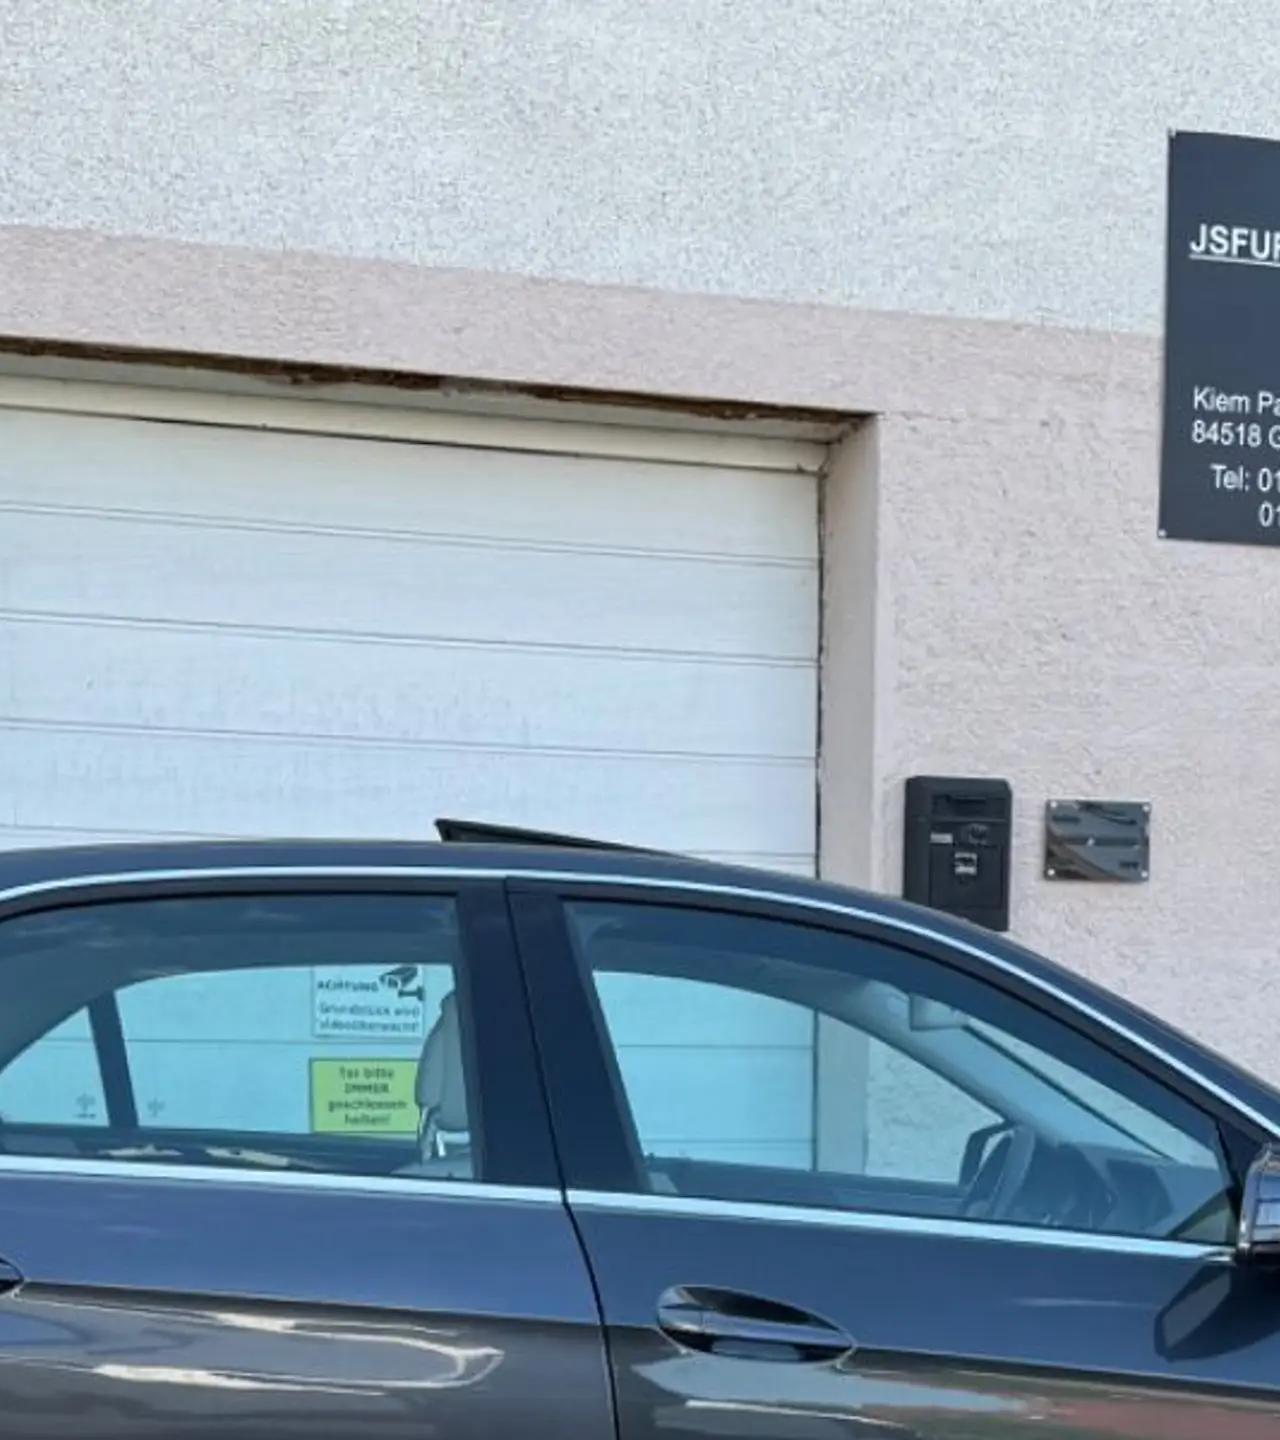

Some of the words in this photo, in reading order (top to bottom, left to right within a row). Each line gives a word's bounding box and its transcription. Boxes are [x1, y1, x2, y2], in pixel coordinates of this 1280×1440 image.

[1193, 386, 1250, 414] Kiem
[1191, 420, 1262, 447] 84518
[1210, 464, 1250, 491] Tel:
